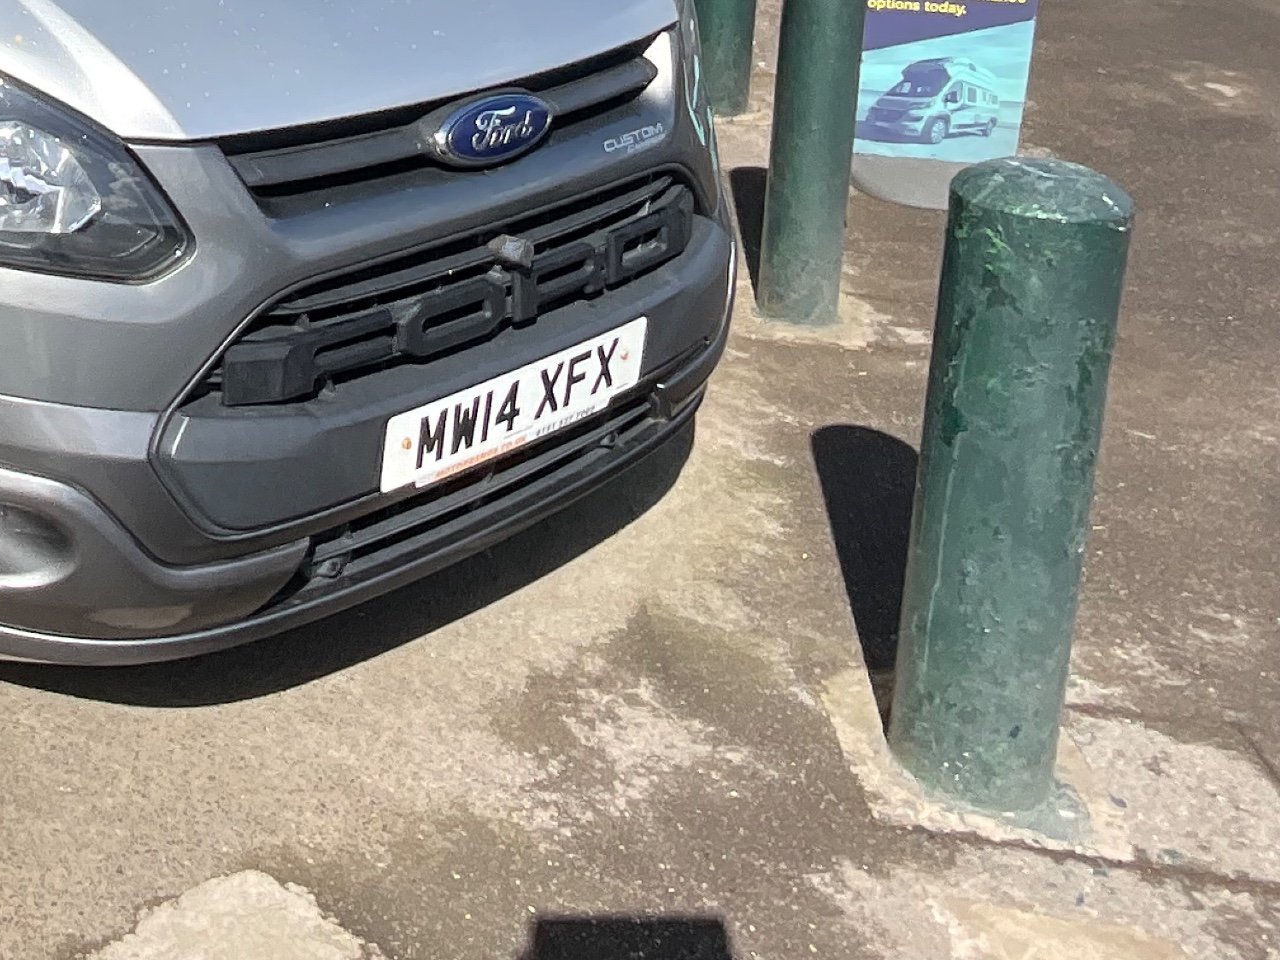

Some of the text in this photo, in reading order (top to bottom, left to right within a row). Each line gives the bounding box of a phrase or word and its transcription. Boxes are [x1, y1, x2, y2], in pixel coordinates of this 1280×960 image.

[924, 1, 967, 17] today.
[472, 105, 534, 151] Ford
[603, 123, 664, 153] CUSTOM
[416, 380, 520, 469] MW14
[535, 339, 619, 420] XFX
